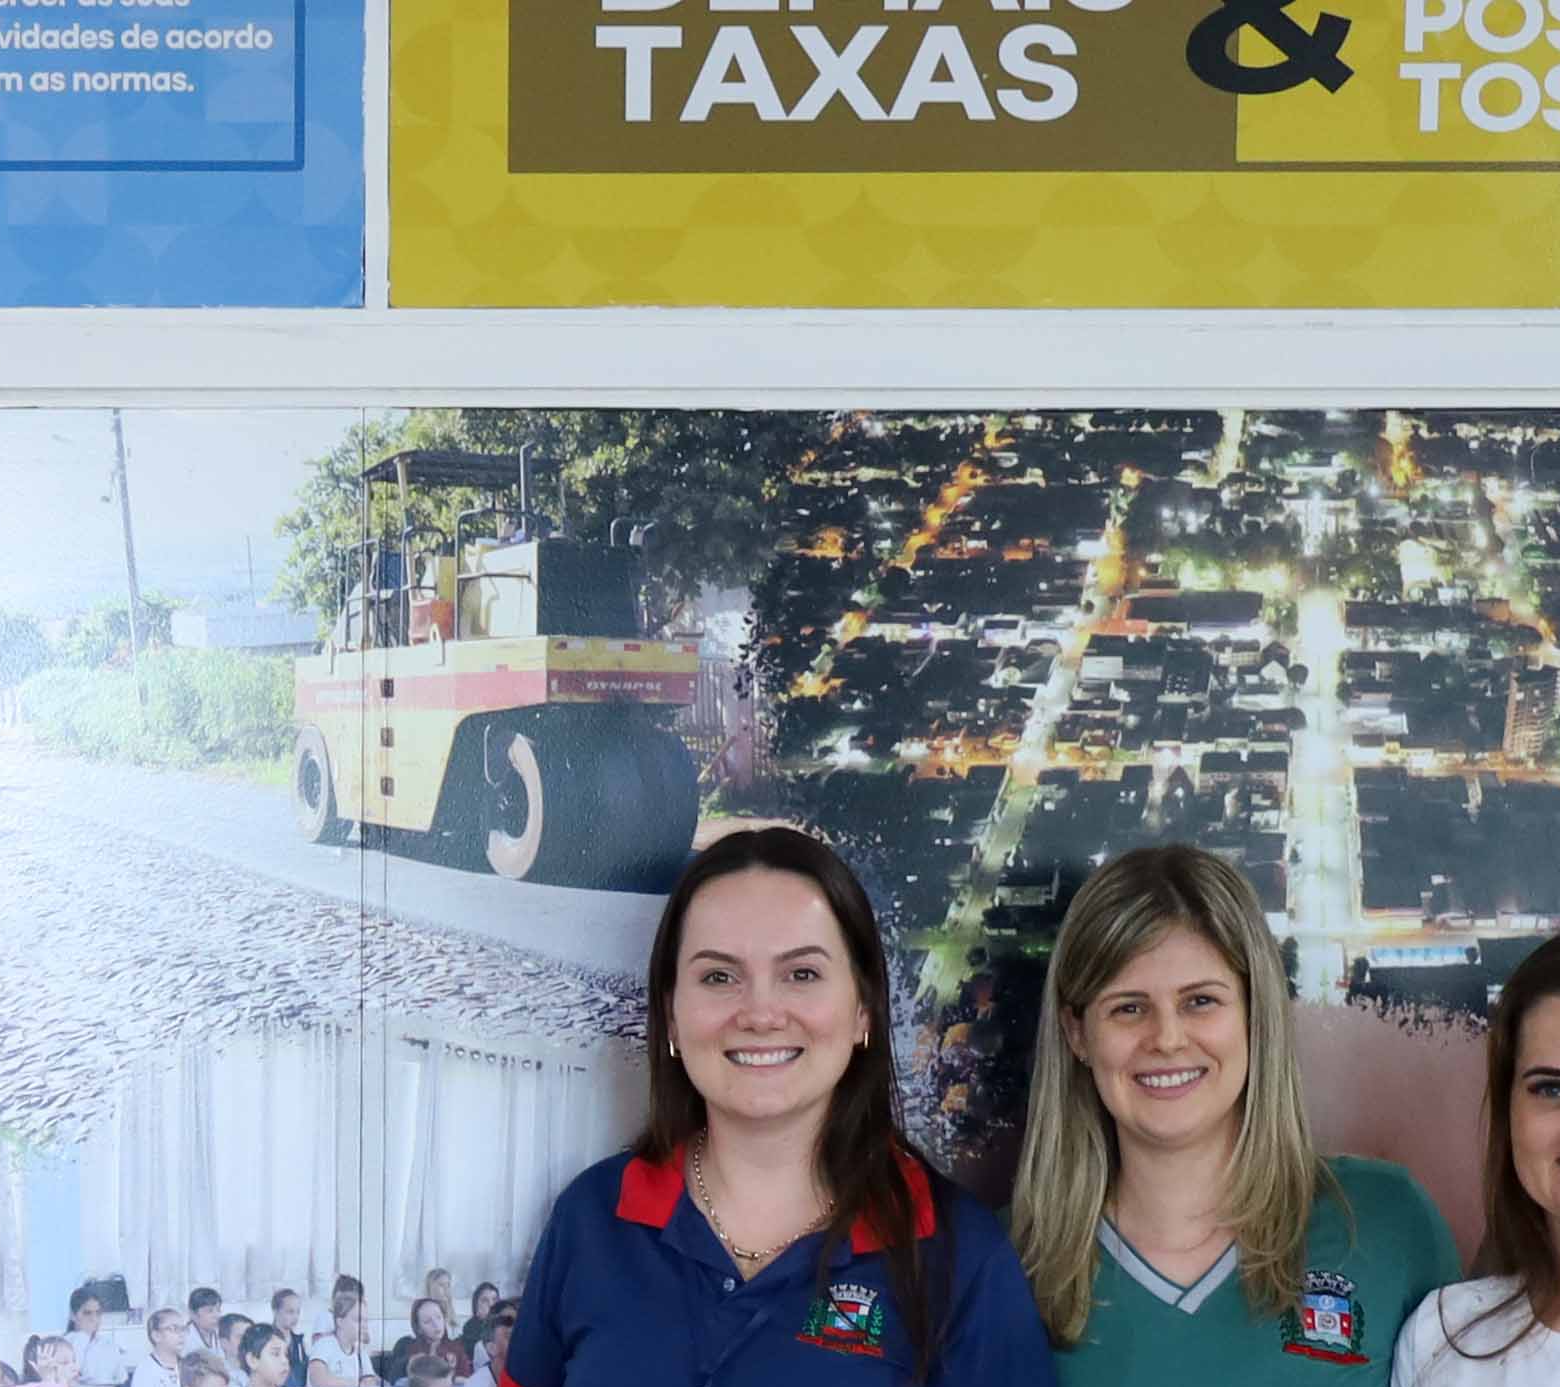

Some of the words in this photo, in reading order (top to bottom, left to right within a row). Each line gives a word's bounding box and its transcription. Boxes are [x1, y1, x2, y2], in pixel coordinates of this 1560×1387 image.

[121, 23, 159, 49] de
[165, 23, 273, 49] acordo
[30, 71, 65, 92] as
[72, 71, 195, 92] normas.
[595, 23, 1079, 121] TAXAS
